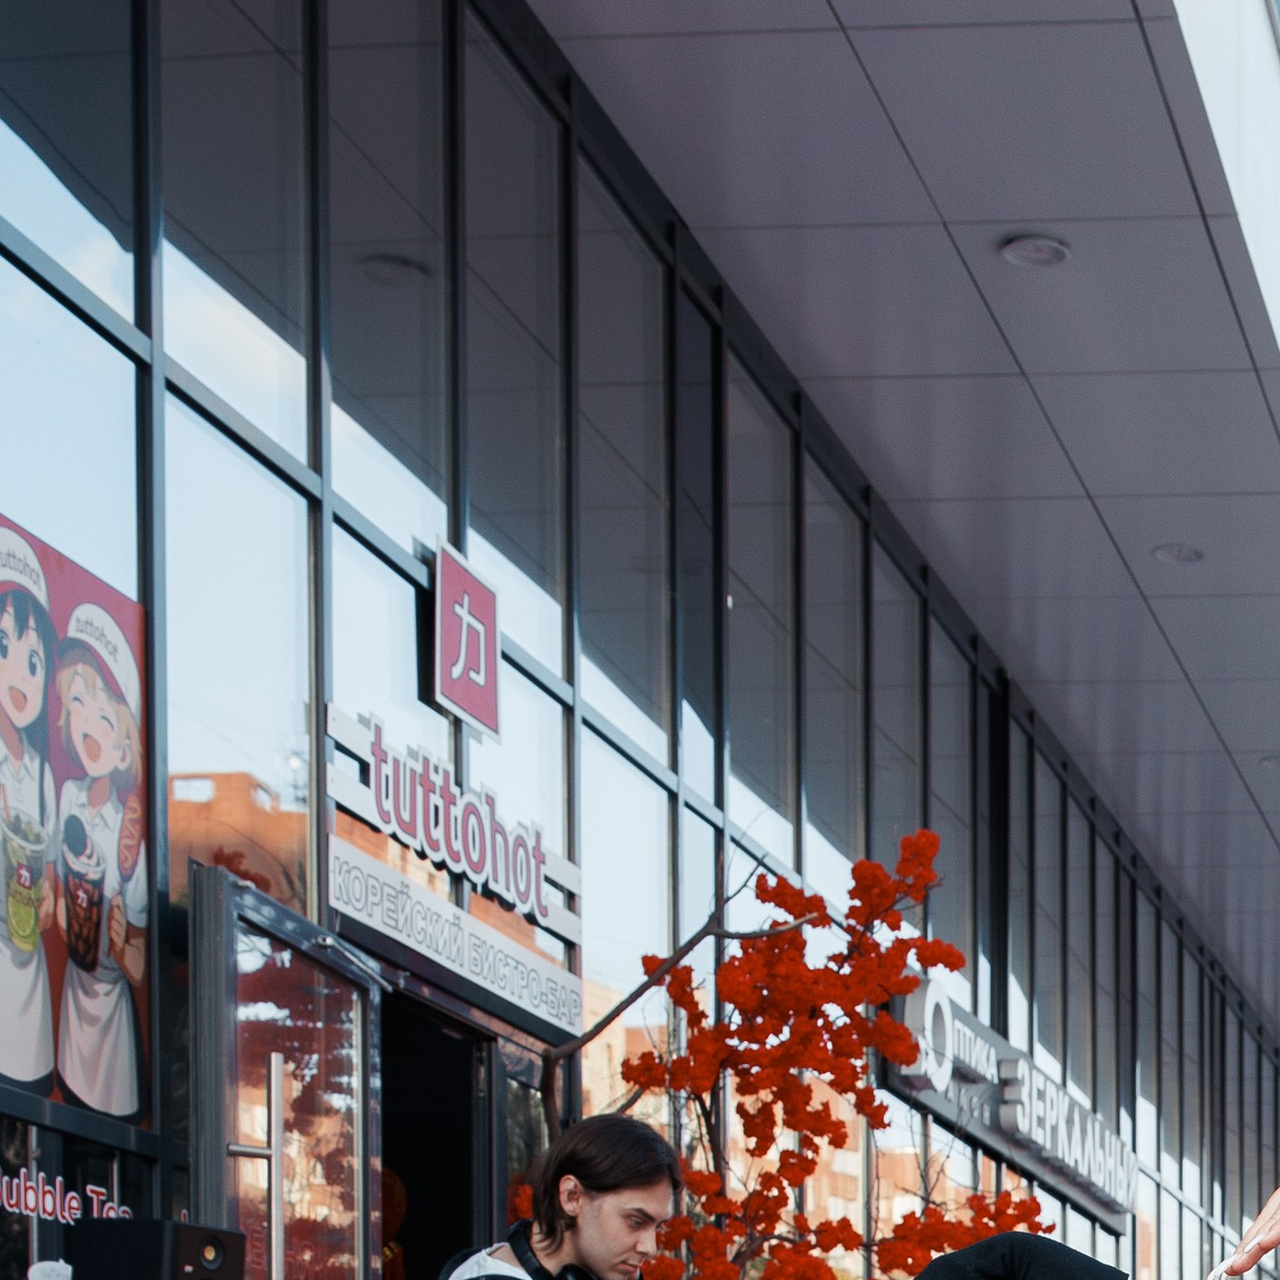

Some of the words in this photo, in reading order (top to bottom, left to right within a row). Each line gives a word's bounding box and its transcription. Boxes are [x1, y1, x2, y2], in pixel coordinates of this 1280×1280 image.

[370, 723, 549, 919] tuttohot
[332, 854, 465, 968] КОРЕЙСКИЙ
[468, 932, 582, 1027] БИСТРО-БАР
[0, 1167, 82, 1225] ubble
